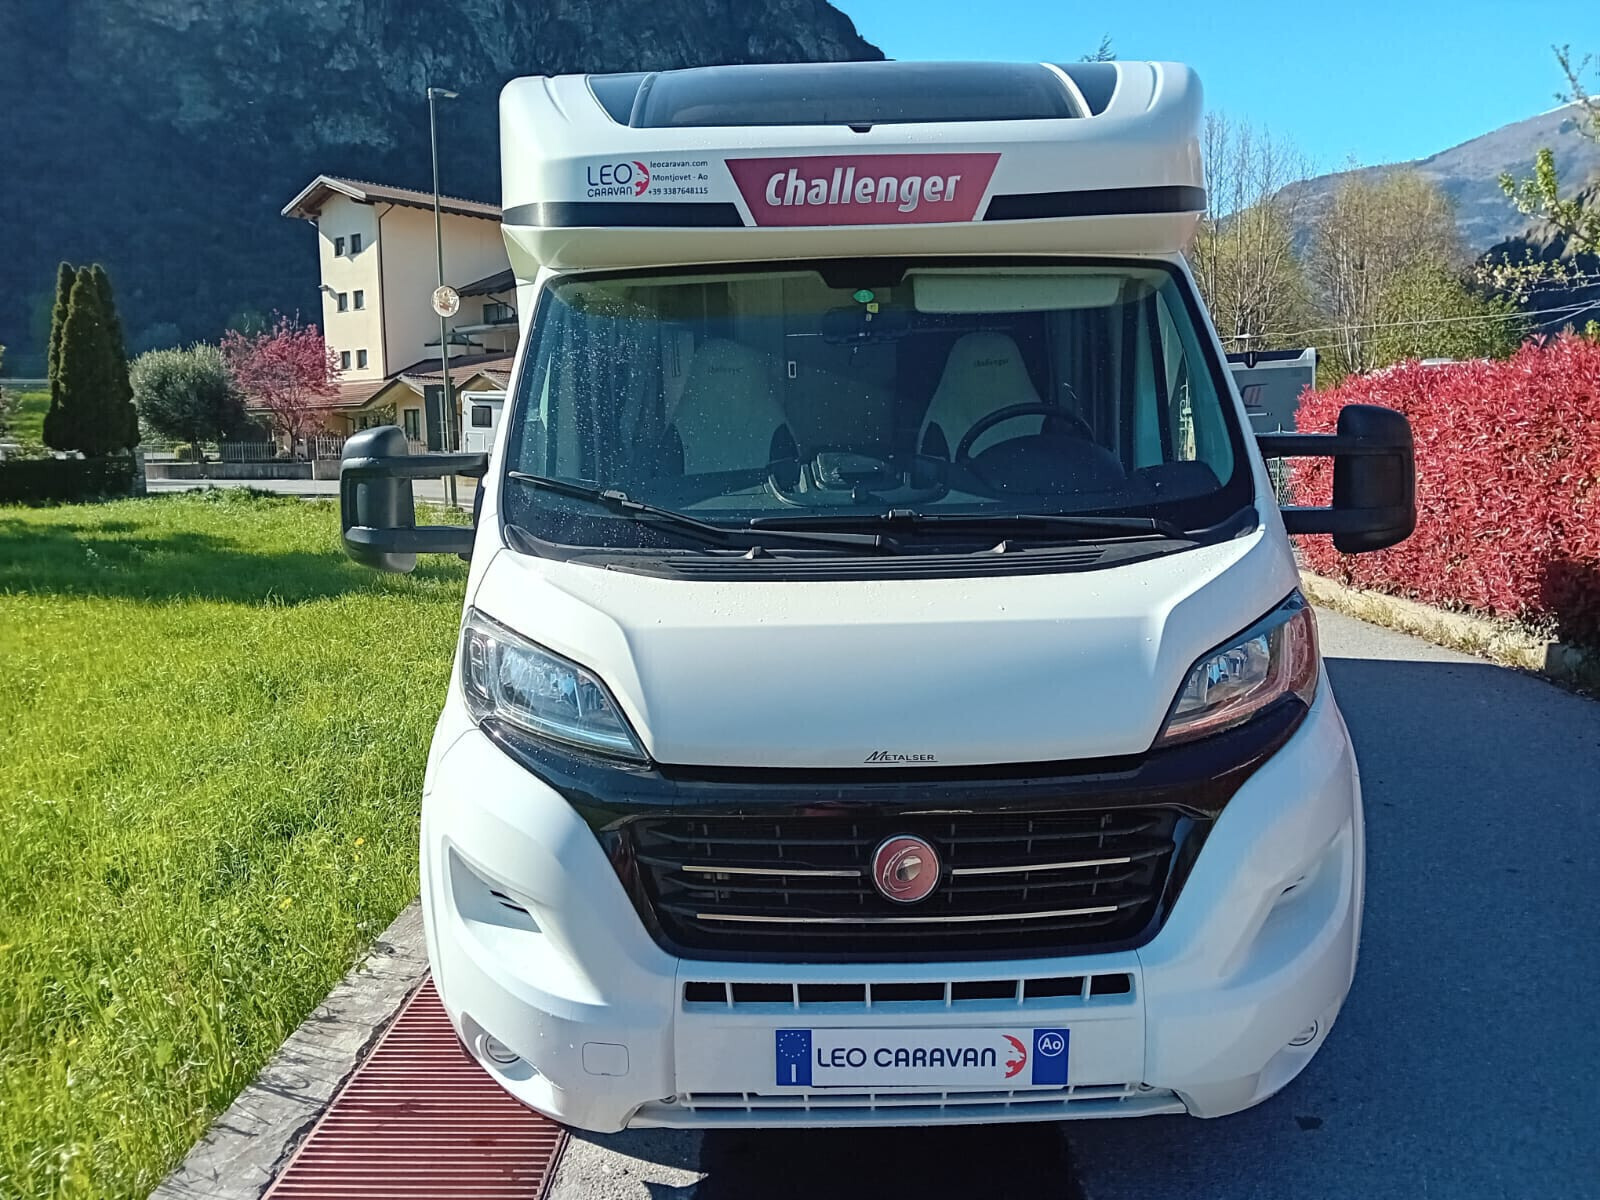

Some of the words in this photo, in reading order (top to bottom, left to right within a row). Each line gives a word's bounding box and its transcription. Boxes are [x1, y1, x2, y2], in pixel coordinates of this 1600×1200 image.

[649, 160, 708, 168] leocaravan.com
[587, 163, 633, 187] LEO
[652, 174, 691, 182] Montjovet
[587, 186, 633, 198] CARAVAN
[648, 188, 662, 196] +39
[663, 186, 709, 195] 3387648115
[765, 166, 961, 213] Challenger
[865, 750, 936, 762] METALSER
[1040, 1036, 1062, 1051] Ao
[816, 1047, 868, 1068] LEO
[873, 1047, 997, 1068] CARAVAN
